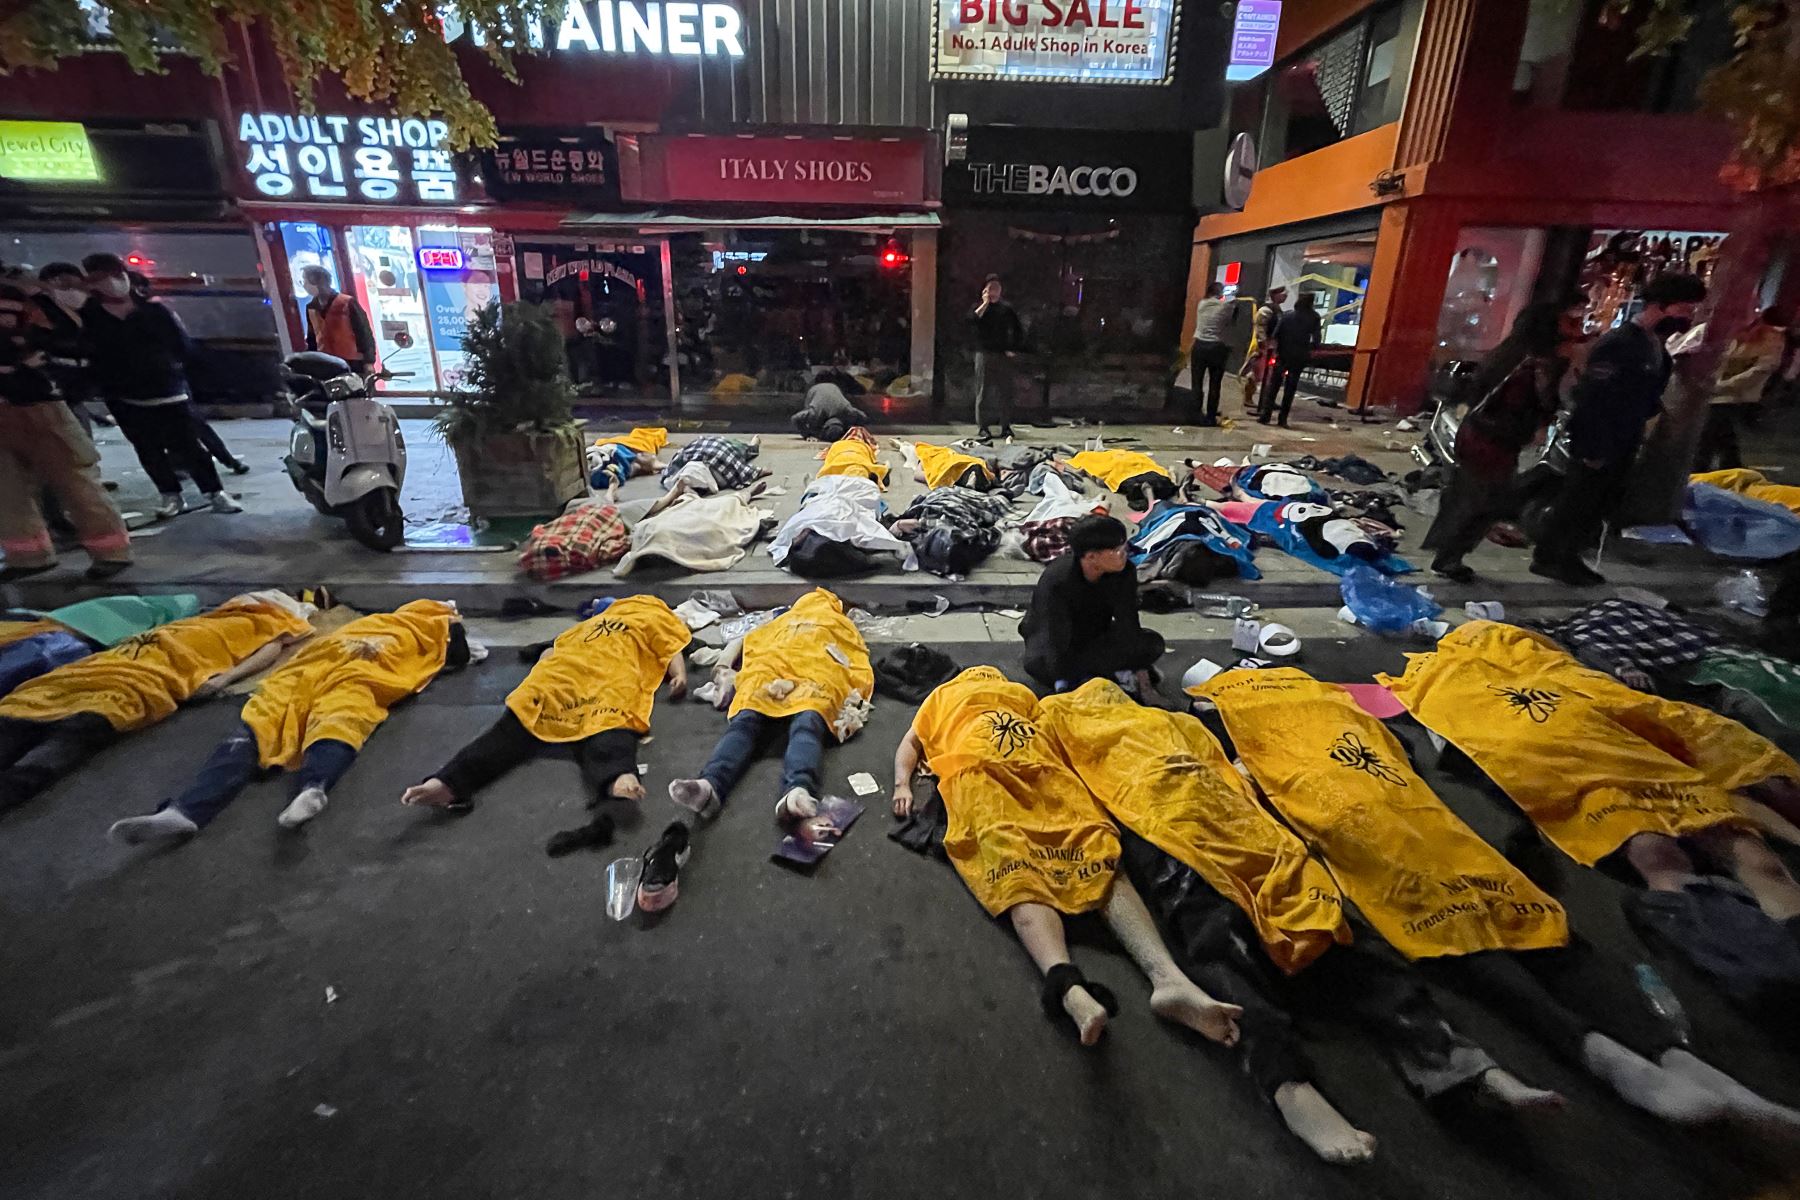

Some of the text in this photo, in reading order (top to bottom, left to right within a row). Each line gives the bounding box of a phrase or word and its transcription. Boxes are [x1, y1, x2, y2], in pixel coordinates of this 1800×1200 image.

[959, 0, 1145, 29] BIG SALE
[952, 34, 1148, 57] No.1 Adult Shop in Korea
[239, 112, 449, 148] ADULT SHOP
[49, 137, 84, 158] City
[245, 143, 457, 201] 성인용품
[720, 157, 873, 182] ITALY SHOES
[423, 251, 459, 267] OPEN
